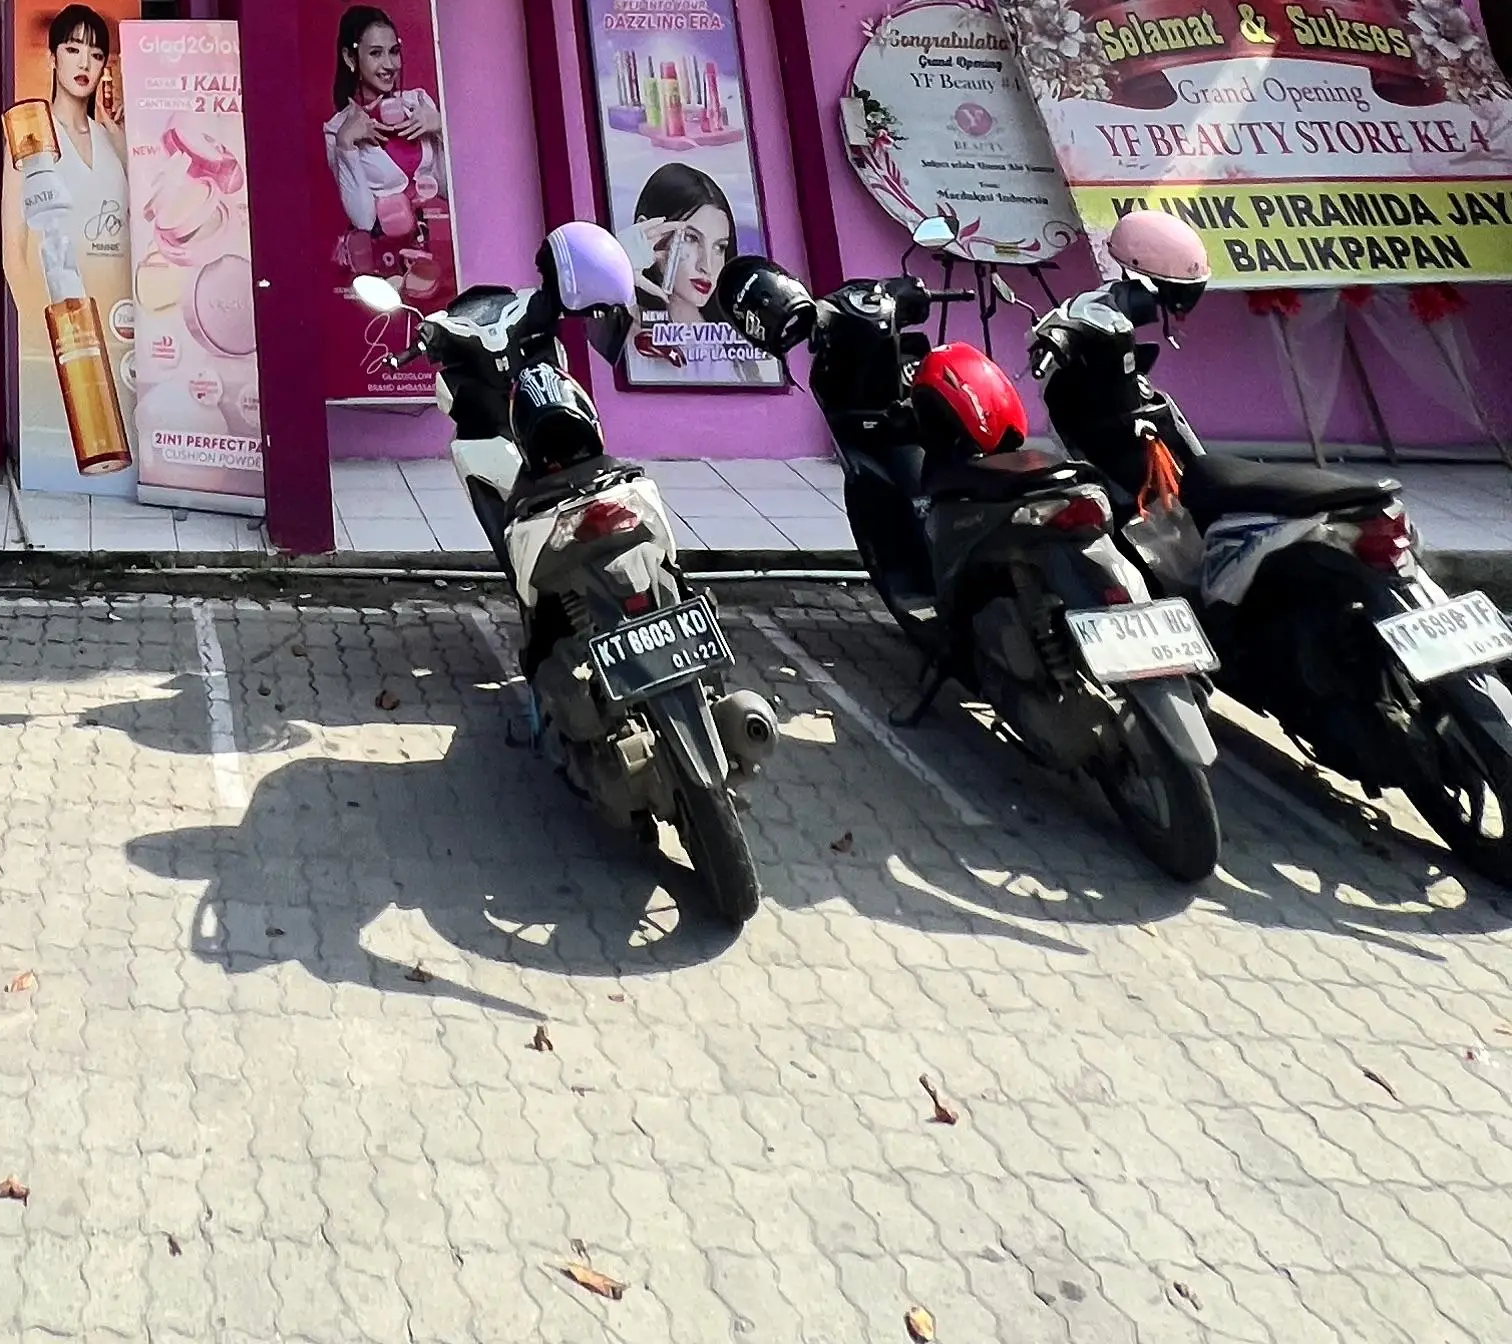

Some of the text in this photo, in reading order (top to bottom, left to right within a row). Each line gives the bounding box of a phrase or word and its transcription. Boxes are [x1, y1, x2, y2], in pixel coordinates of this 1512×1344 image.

[614, 0, 643, 11] STEP
[605, 14, 722, 30] DAZZLING ERA
[1095, 2, 1413, 63] Selamat & Sukses
[181, 75, 188, 91] 1
[194, 75, 242, 96] KALI,
[910, 72, 937, 89] YF
[940, 74, 995, 94] Beauty
[194, 97, 206, 113] 2
[1177, 77, 1371, 114] Grand Opening
[1095, 119, 1489, 157] YF BEAUTY STORE KE 4
[1248, 193, 1437, 228] PIRAMIDA
[1446, 192, 1512, 226] JAY
[1223, 235, 1473, 272] BALIKPAPAN
[643, 310, 669, 322] NEW!
[688, 347, 709, 361] LIP
[155, 432, 182, 449] 2IN1
[186, 434, 246, 452] PERFECT
[164, 448, 215, 464] CUSHION
[1076, 619, 1103, 646] KT
[597, 634, 626, 668] KT
